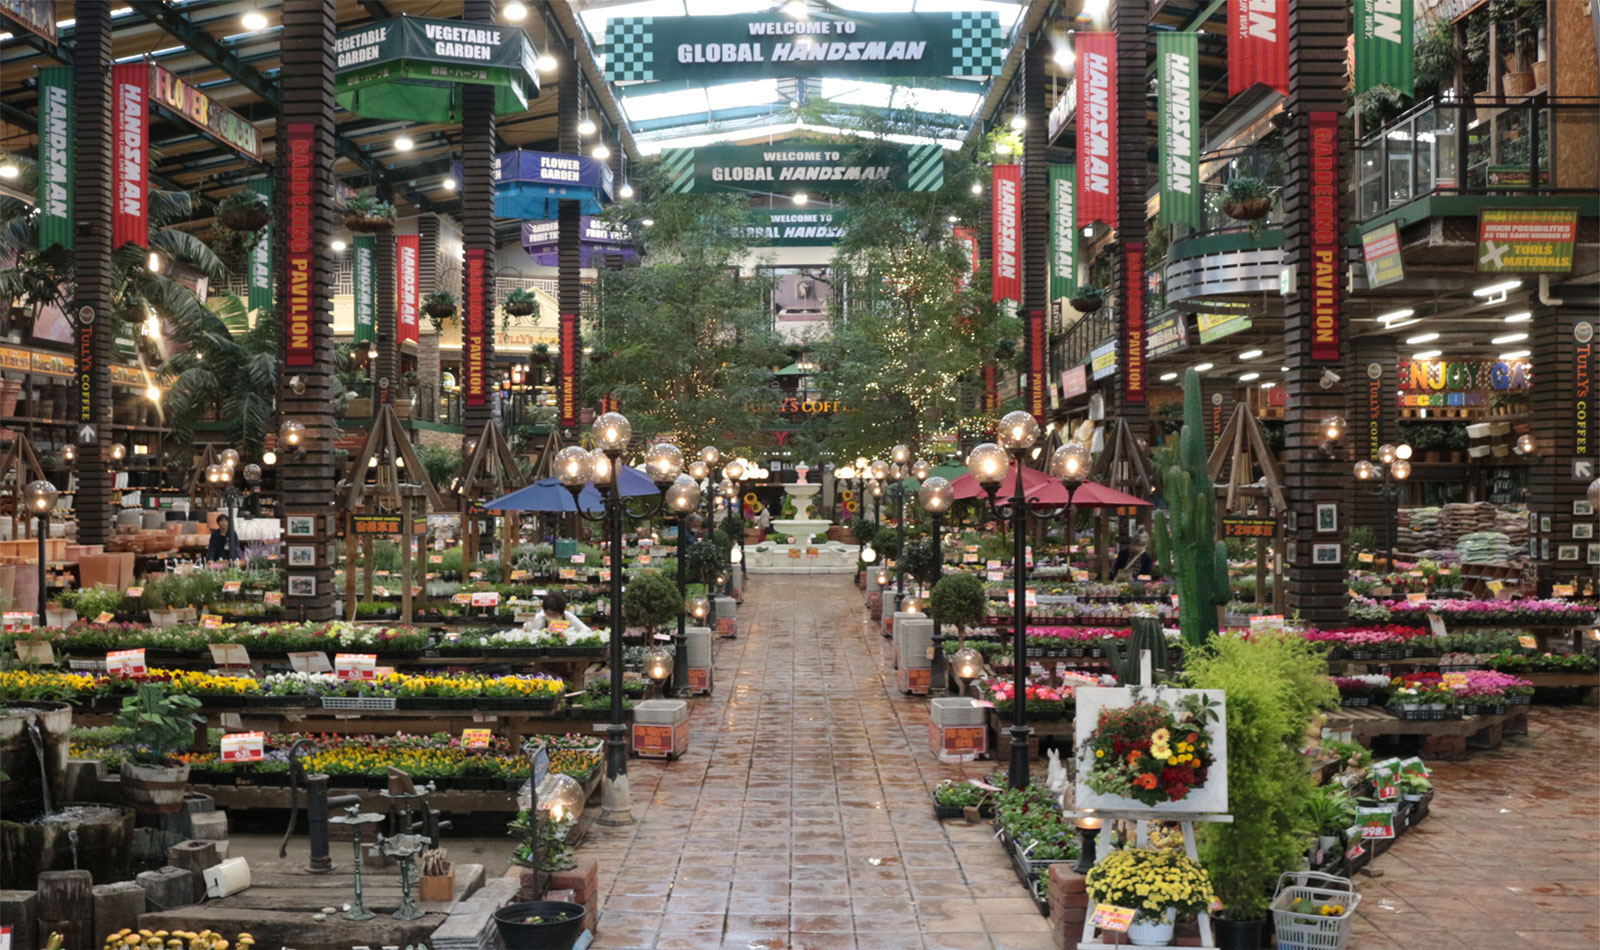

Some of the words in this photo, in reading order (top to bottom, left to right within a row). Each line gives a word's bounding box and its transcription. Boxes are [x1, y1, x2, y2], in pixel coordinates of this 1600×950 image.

[425, 24, 500, 45] VEGETABLE
[749, 22, 830, 35] WELCOME
[834, 21, 856, 34] TO
[338, 45, 380, 68] GARDEN
[435, 42, 491, 60] GARDEN
[677, 43, 764, 63] GLOBAL
[771, 41, 927, 61] HANDSMAN
[156, 67, 208, 125] FLOWER
[220, 109, 257, 155] GREEN
[1090, 52, 1109, 195] HANDSMAN
[1171, 52, 1191, 195] HANDSMAN
[50, 86, 67, 218] HANDSMAN
[124, 83, 141, 217] HANDSMAN
[541, 157, 580, 170] FLOWER
[763, 152, 821, 161] WELCOME
[824, 152, 840, 161] TO
[541, 169, 580, 182] GARDEN
[712, 167, 774, 181] GLOBAL
[779, 166, 891, 181] HANDSMAN
[1314, 128, 1333, 245] GARDENING
[291, 139, 309, 253] GARDENING
[532, 218, 559, 233] GARDE
[586, 229, 608, 239] FRUIT
[770, 215, 818, 223] WELCOME
[784, 226, 850, 239] HANDS
[1002, 179, 1016, 279] HANDSMAN
[1060, 179, 1073, 279] HANDSMAN
[1503, 256, 1572, 267] MATERIALS.
[1514, 245, 1553, 255] TOOLS
[291, 258, 308, 348] PAVILION
[360, 247, 371, 325] HANDSMAN
[404, 246, 416, 325] HANDSMAN
[1316, 250, 1333, 342] PAVILION
[470, 336, 482, 394] PAVILION
[1129, 331, 1141, 390] PAVILION
[1398, 362, 1483, 389] ENJOY
[81, 374, 91, 420] COFFEE
[563, 376, 573, 418] PAVILION
[1033, 373, 1042, 416] PAVILION
[1370, 421, 1378, 460] COFFEE
[1576, 401, 1587, 454] COFFEE
